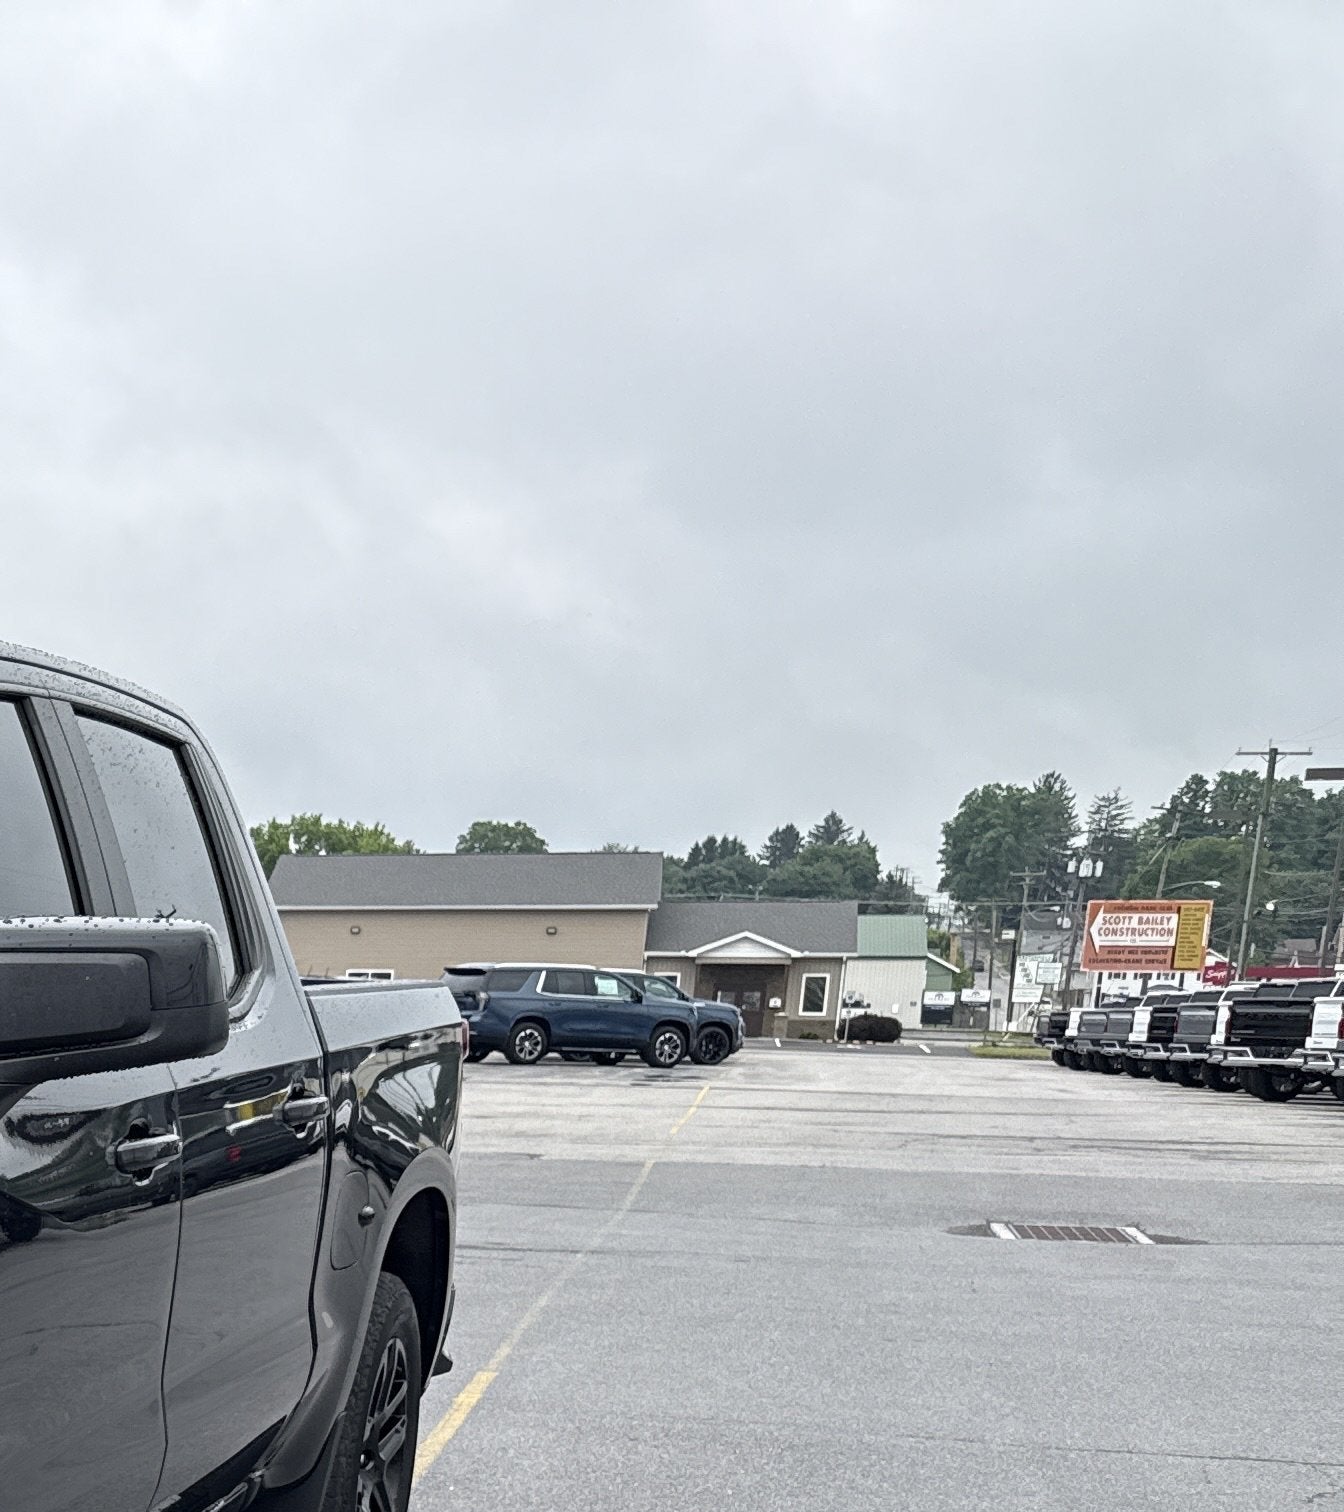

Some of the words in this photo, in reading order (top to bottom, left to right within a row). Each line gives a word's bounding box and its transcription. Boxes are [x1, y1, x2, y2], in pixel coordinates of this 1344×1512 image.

[1102, 916, 1133, 926] SCOTT
[1137, 916, 1172, 926] BAILEY
[1097, 927, 1174, 937] CONSTRUCTION
